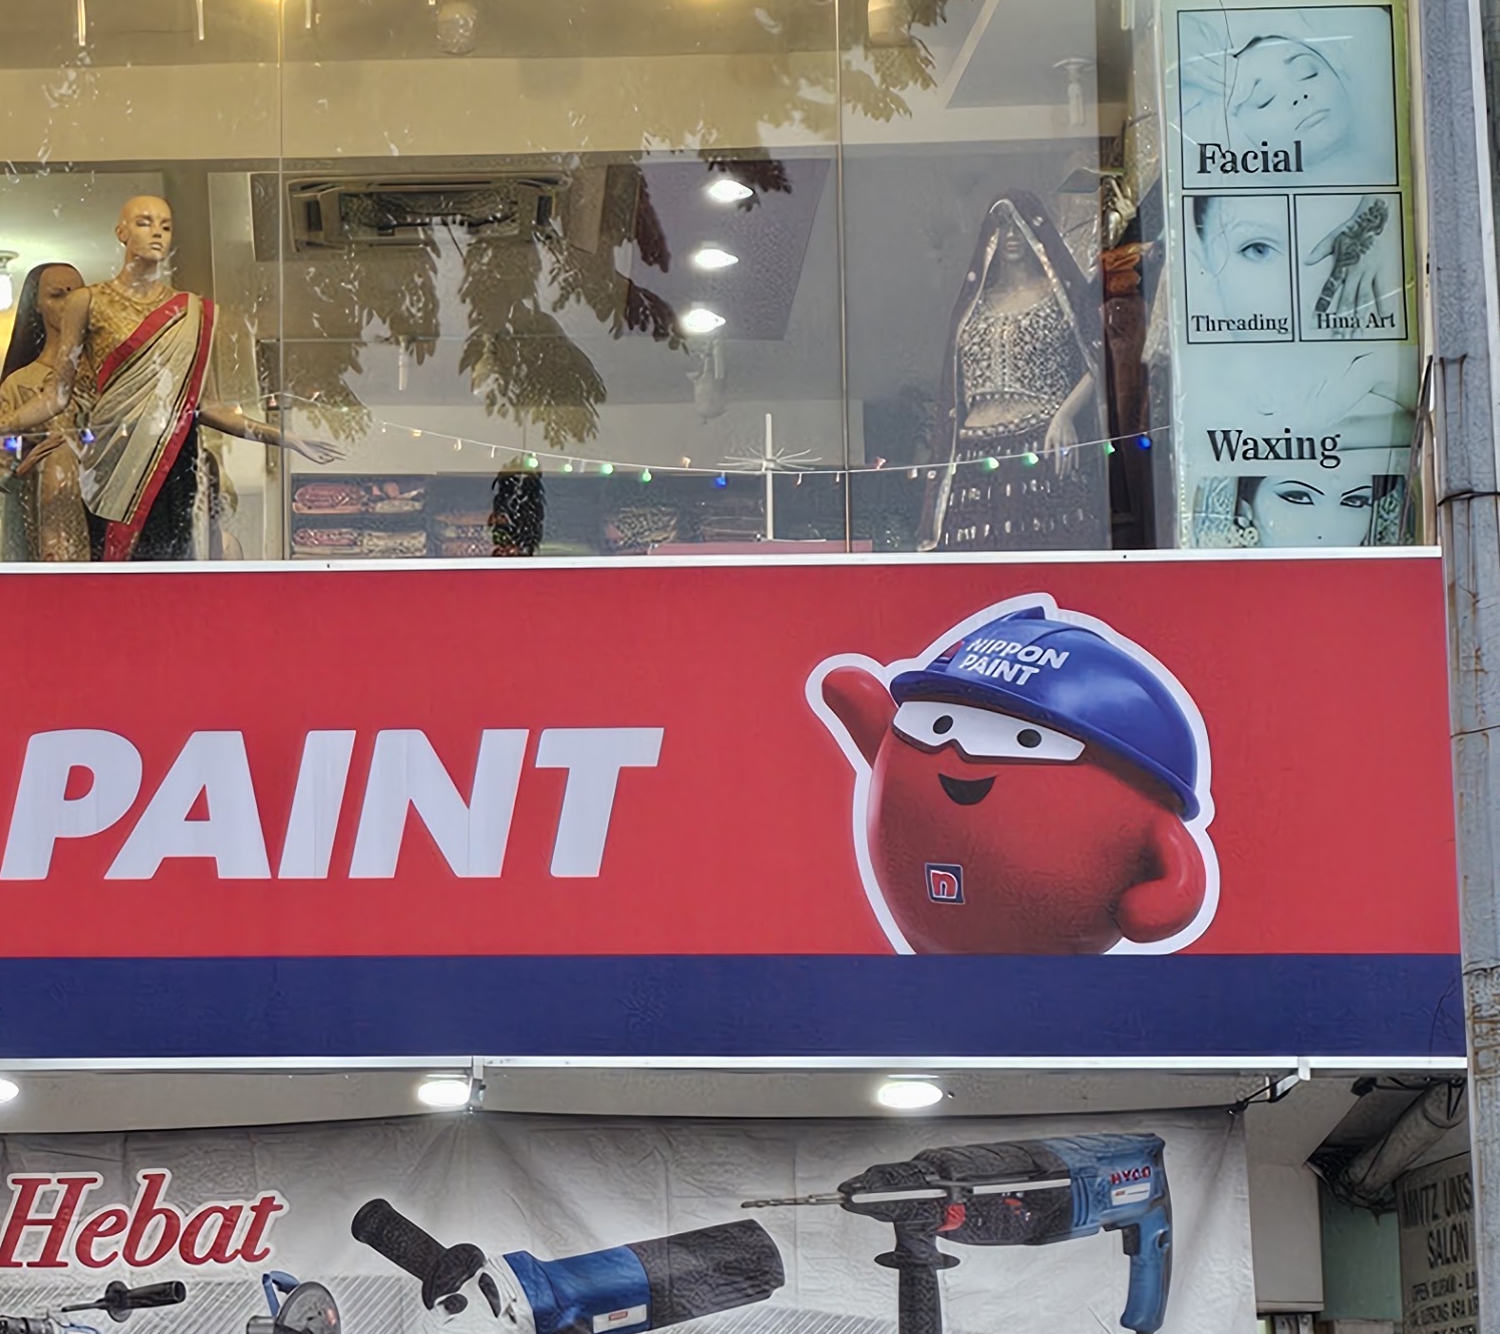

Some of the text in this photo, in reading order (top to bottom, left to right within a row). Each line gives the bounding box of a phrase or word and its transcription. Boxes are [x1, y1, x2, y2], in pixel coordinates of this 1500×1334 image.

[1197, 140, 1304, 174] Facial
[1191, 314, 1289, 334] Threading
[1366, 312, 1396, 329] Art
[1207, 427, 1341, 469] Waxing
[966, 638, 1070, 669] NIPPON
[961, 654, 1040, 686] PAINT
[0, 727, 664, 880] PAINT
